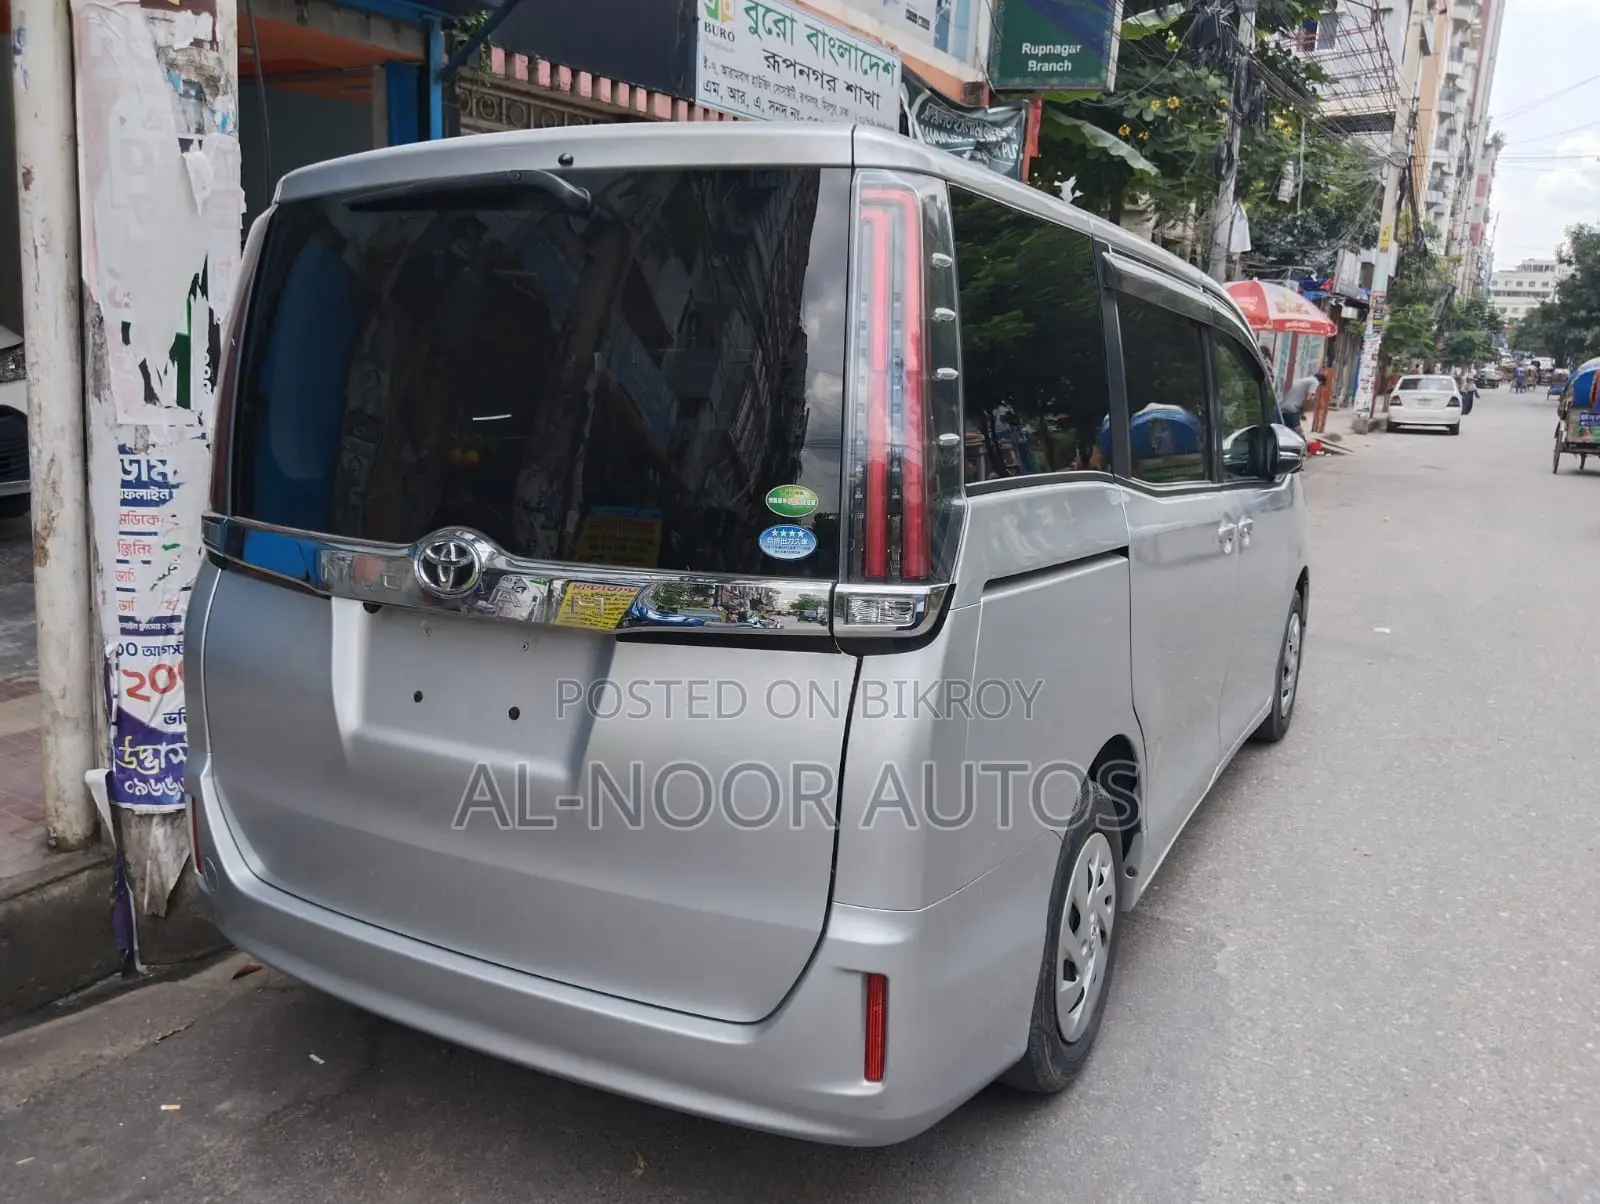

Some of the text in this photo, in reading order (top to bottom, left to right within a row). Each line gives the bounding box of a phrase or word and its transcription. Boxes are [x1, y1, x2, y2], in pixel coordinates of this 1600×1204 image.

[704, 21, 735, 42] BURO
[744, 0, 896, 86] বুরো বাংলাদেশ
[1021, 43, 1082, 57] Rupnagar
[1028, 60, 1072, 72] Branch
[762, 48, 882, 110] রূপনগর শাখা
